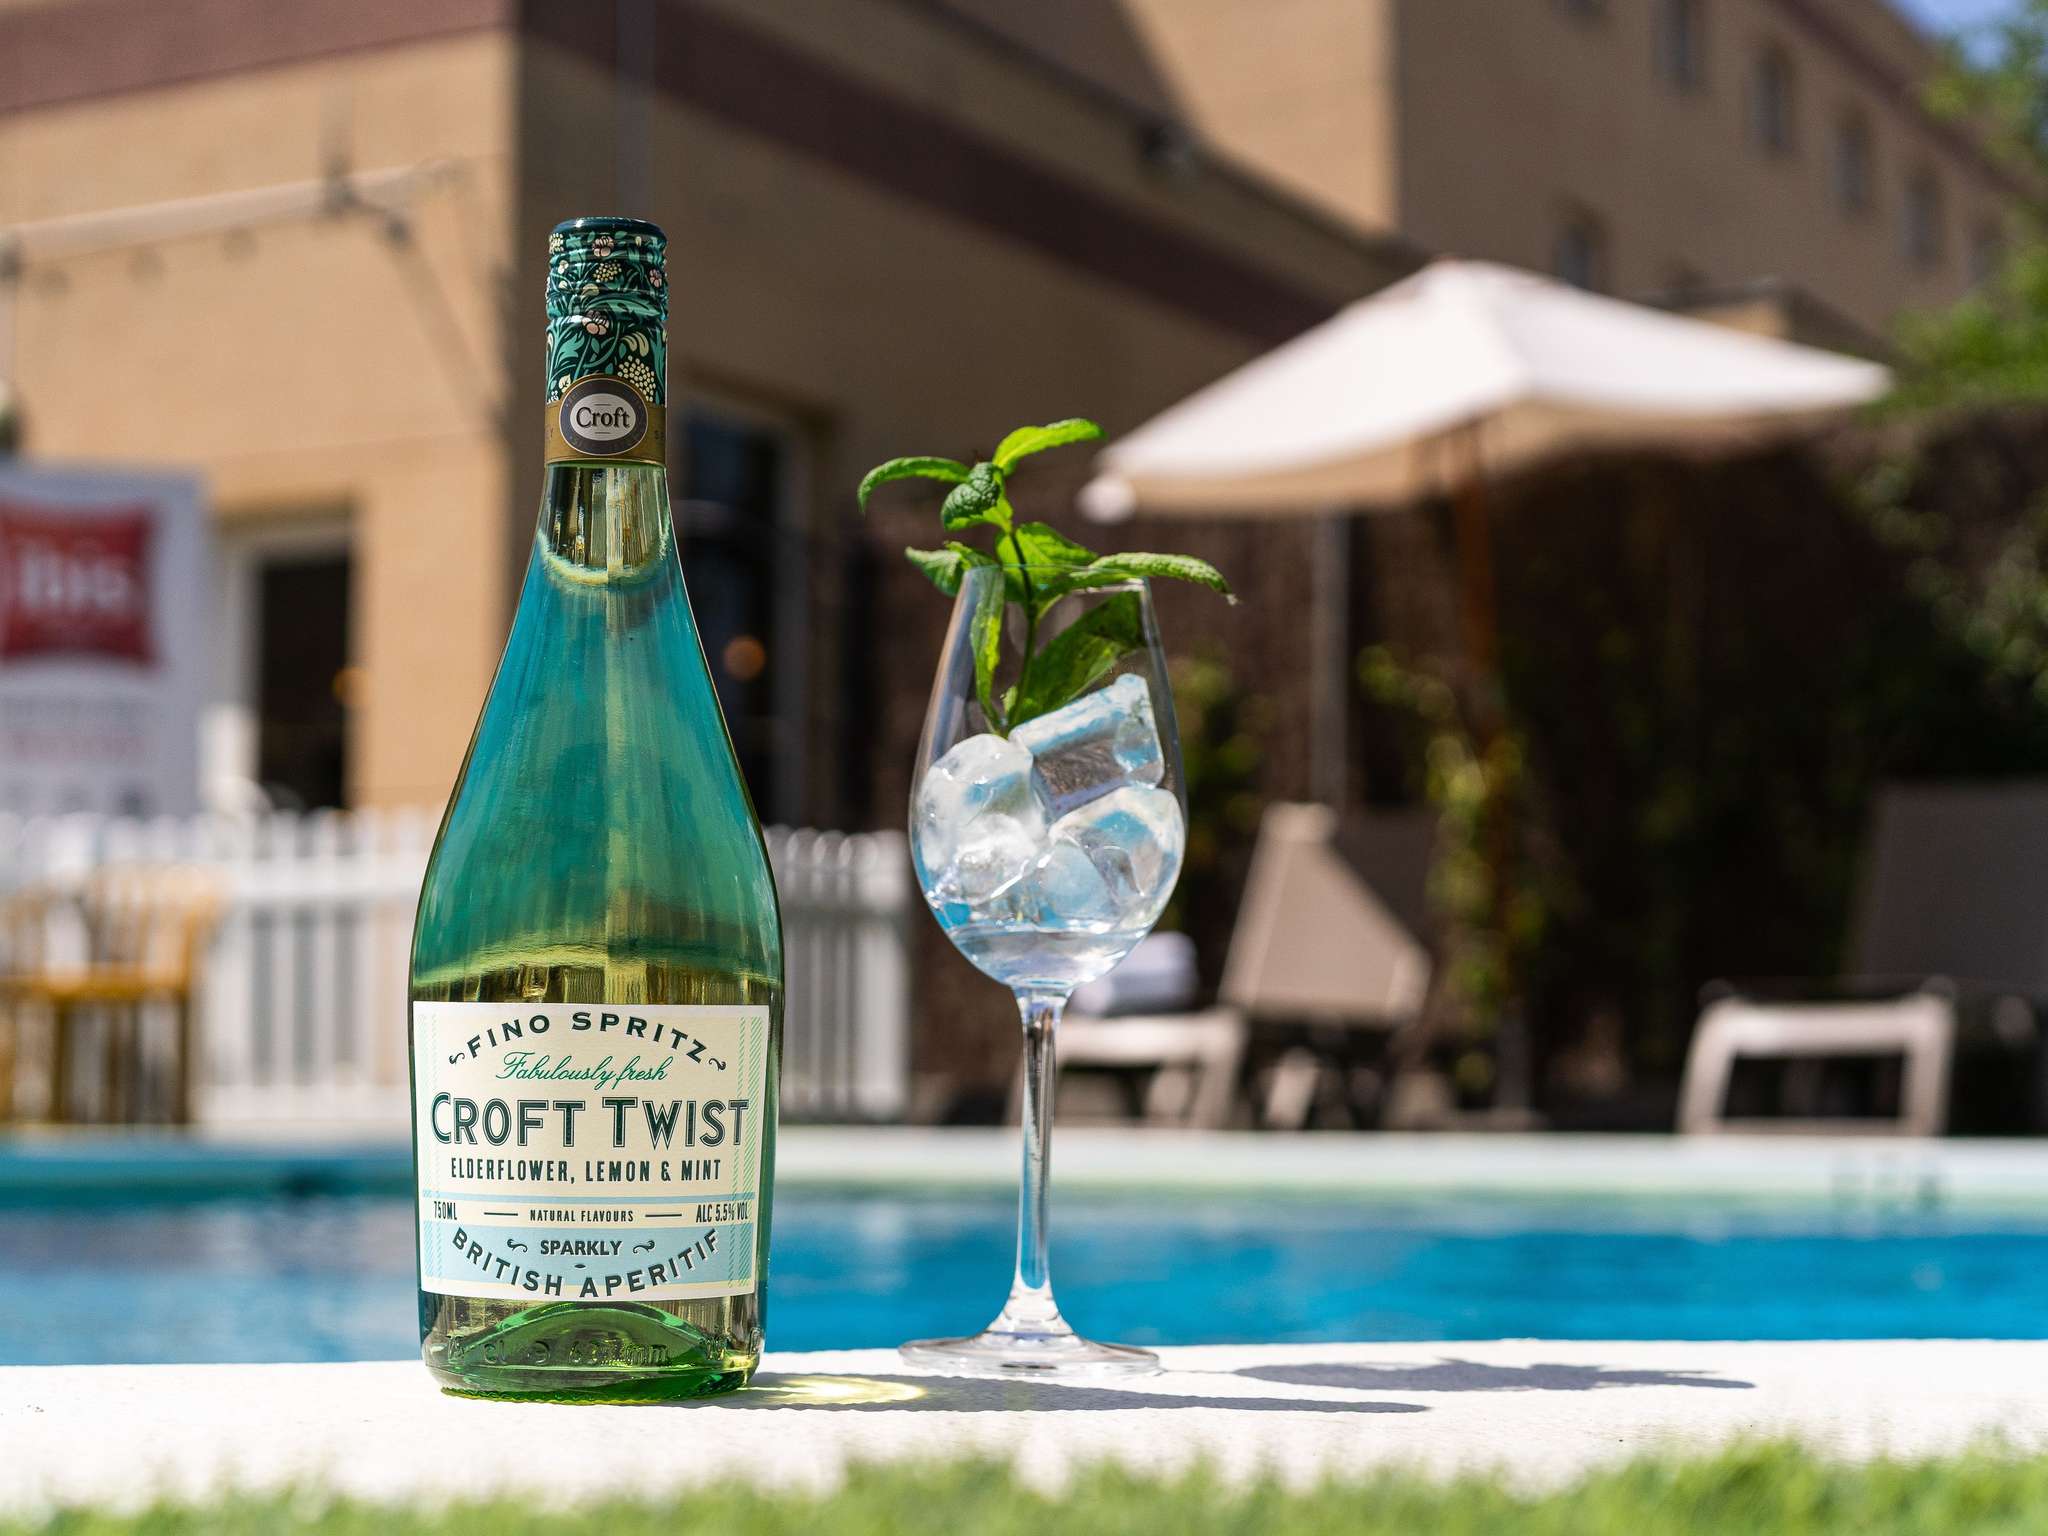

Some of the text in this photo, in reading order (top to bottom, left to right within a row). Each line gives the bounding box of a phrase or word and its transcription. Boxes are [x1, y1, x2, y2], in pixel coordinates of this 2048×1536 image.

[576, 406, 631, 428] Croft
[466, 1011, 707, 1064] FINO SPRITZ
[496, 1052, 674, 1091] Fabulously fresh
[431, 1091, 750, 1151] CROFT TWIST
[451, 1157, 721, 1184] ELDERFLOWER, LEMON & MINT
[434, 1200, 458, 1221] 750ML
[530, 1209, 634, 1223] NATURAL FLAVOURS
[695, 1201, 748, 1223] ALC 5.5% VOL
[540, 1239, 623, 1256] SPARKLY
[452, 1227, 718, 1298] BRITISH APERITIF
